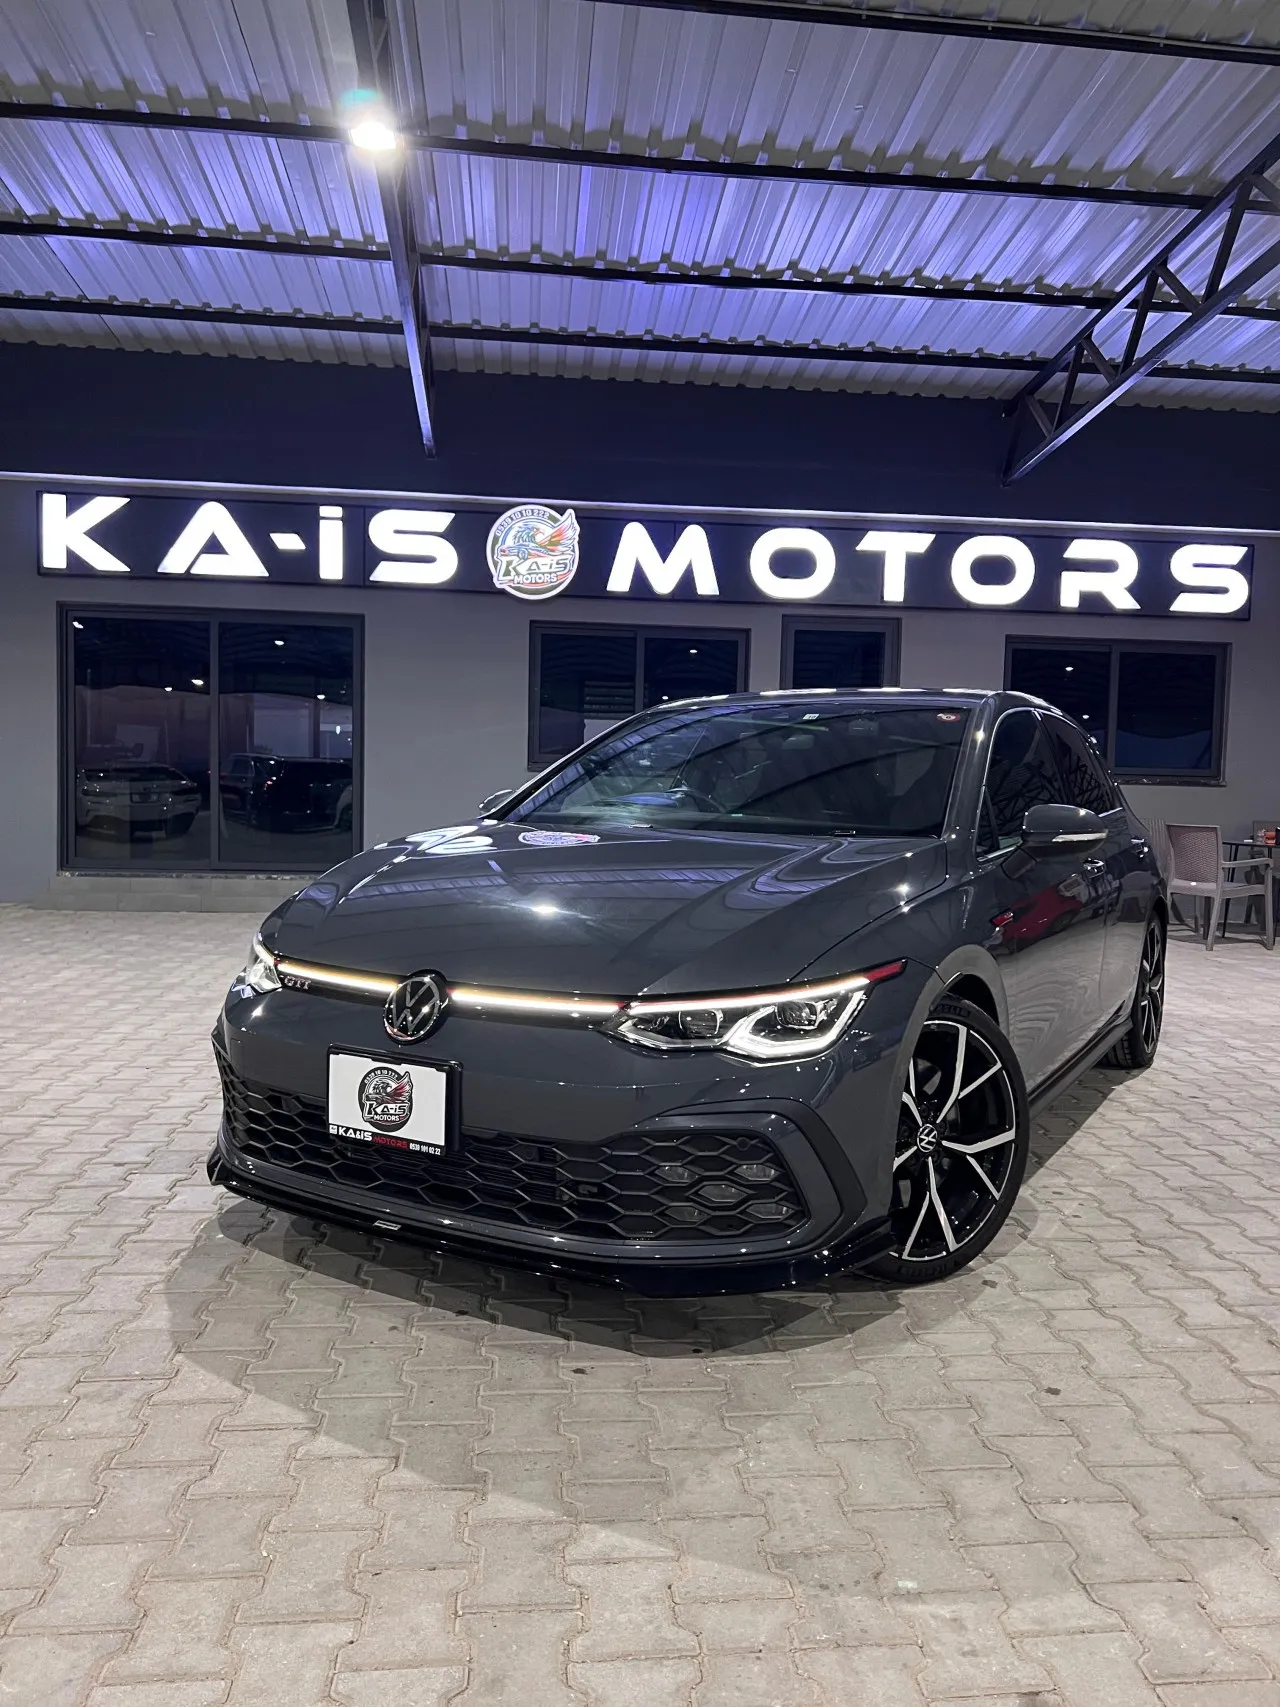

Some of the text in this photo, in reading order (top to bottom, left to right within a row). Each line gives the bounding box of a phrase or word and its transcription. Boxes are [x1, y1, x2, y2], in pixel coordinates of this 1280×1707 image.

[495, 509, 550, 536] 0539 10 10 222
[607, 521, 1251, 613] MOTORS
[513, 573, 558, 584] MOTORS
[284, 975, 312, 990] GTI
[374, 1136, 408, 1148] MOTORS
[434, 1148, 441, 1156] 22
